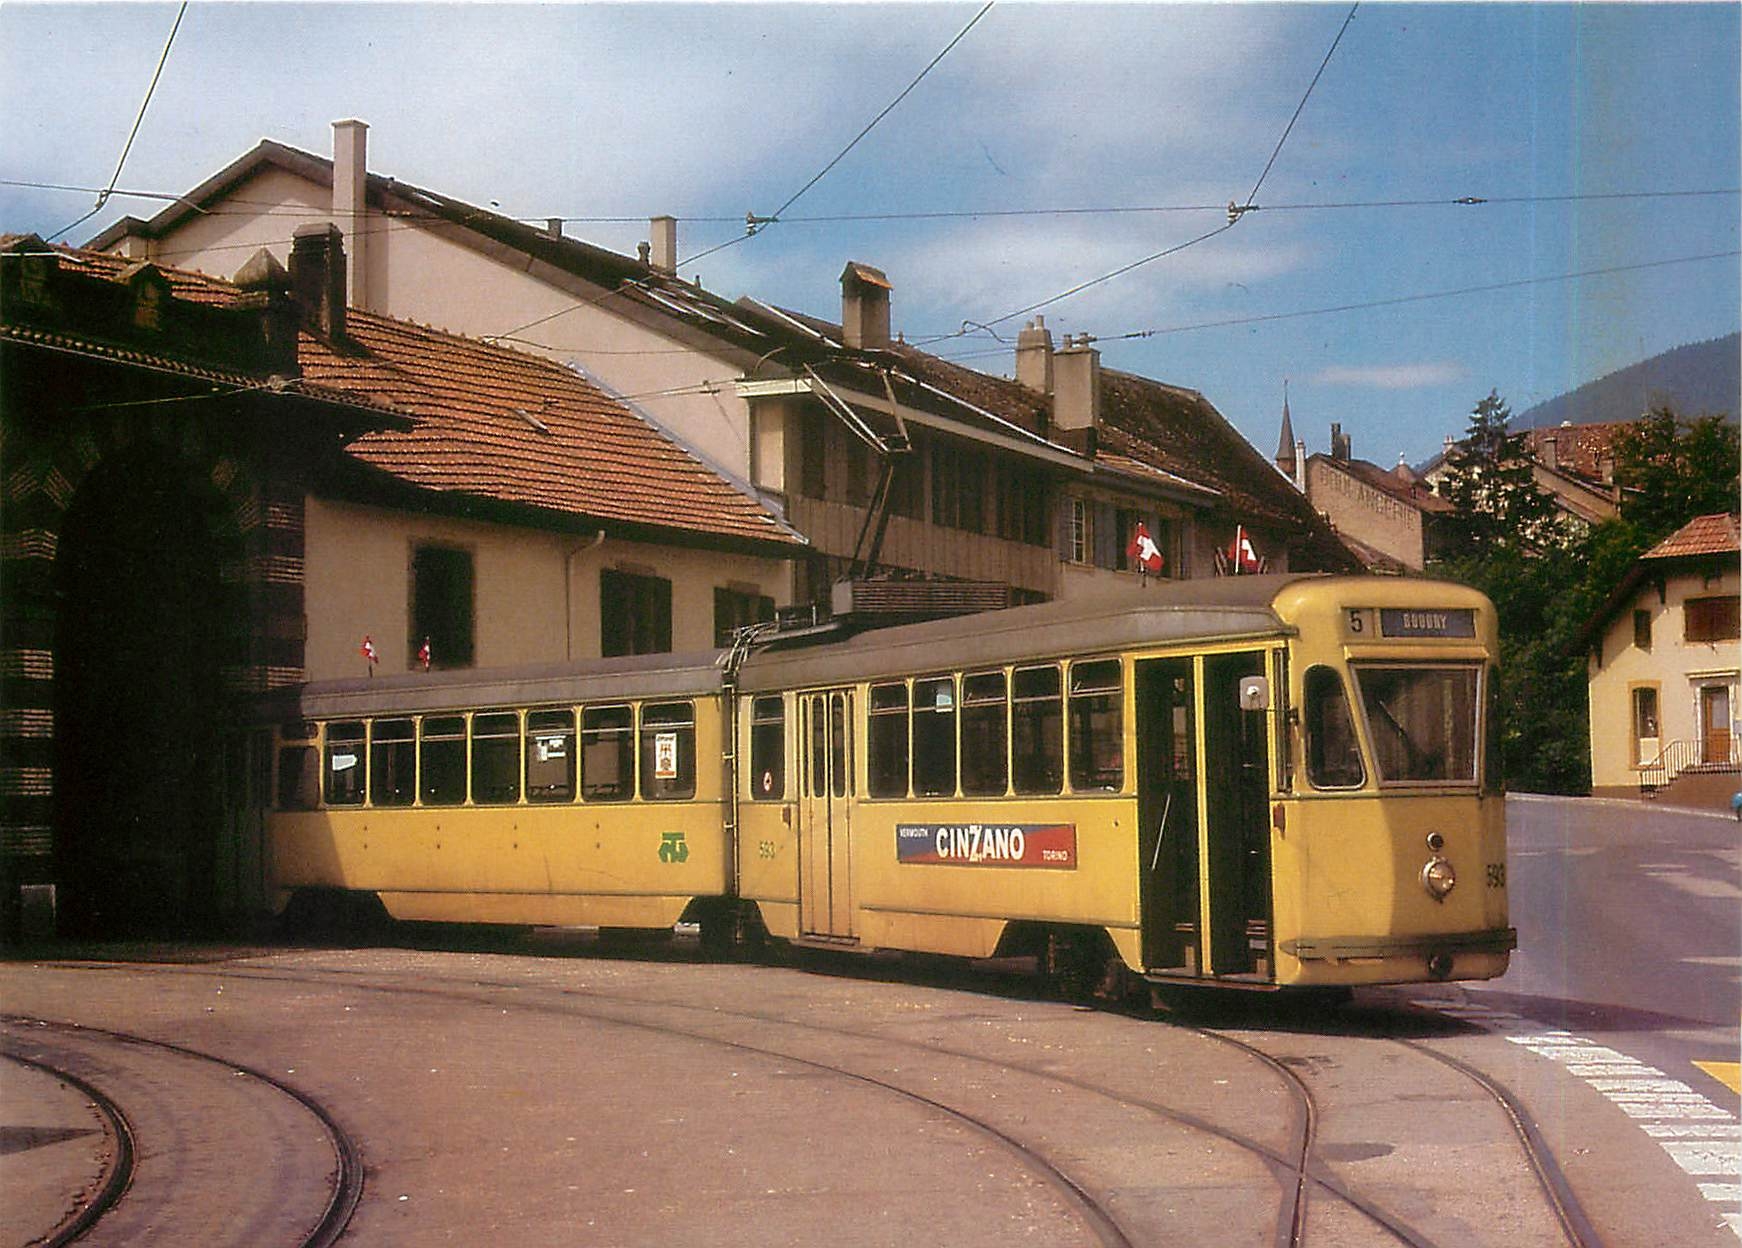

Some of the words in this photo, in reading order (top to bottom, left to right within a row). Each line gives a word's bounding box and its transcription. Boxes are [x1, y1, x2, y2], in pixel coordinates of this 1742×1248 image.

[1350, 609, 1363, 633] 5
[1403, 613, 1447, 630] BOUDRY
[899, 827, 929, 839] VERMOUTH
[936, 825, 1025, 862] CINZANO
[1043, 849, 1068, 861] TORINO
[1487, 863, 1505, 887] 593
